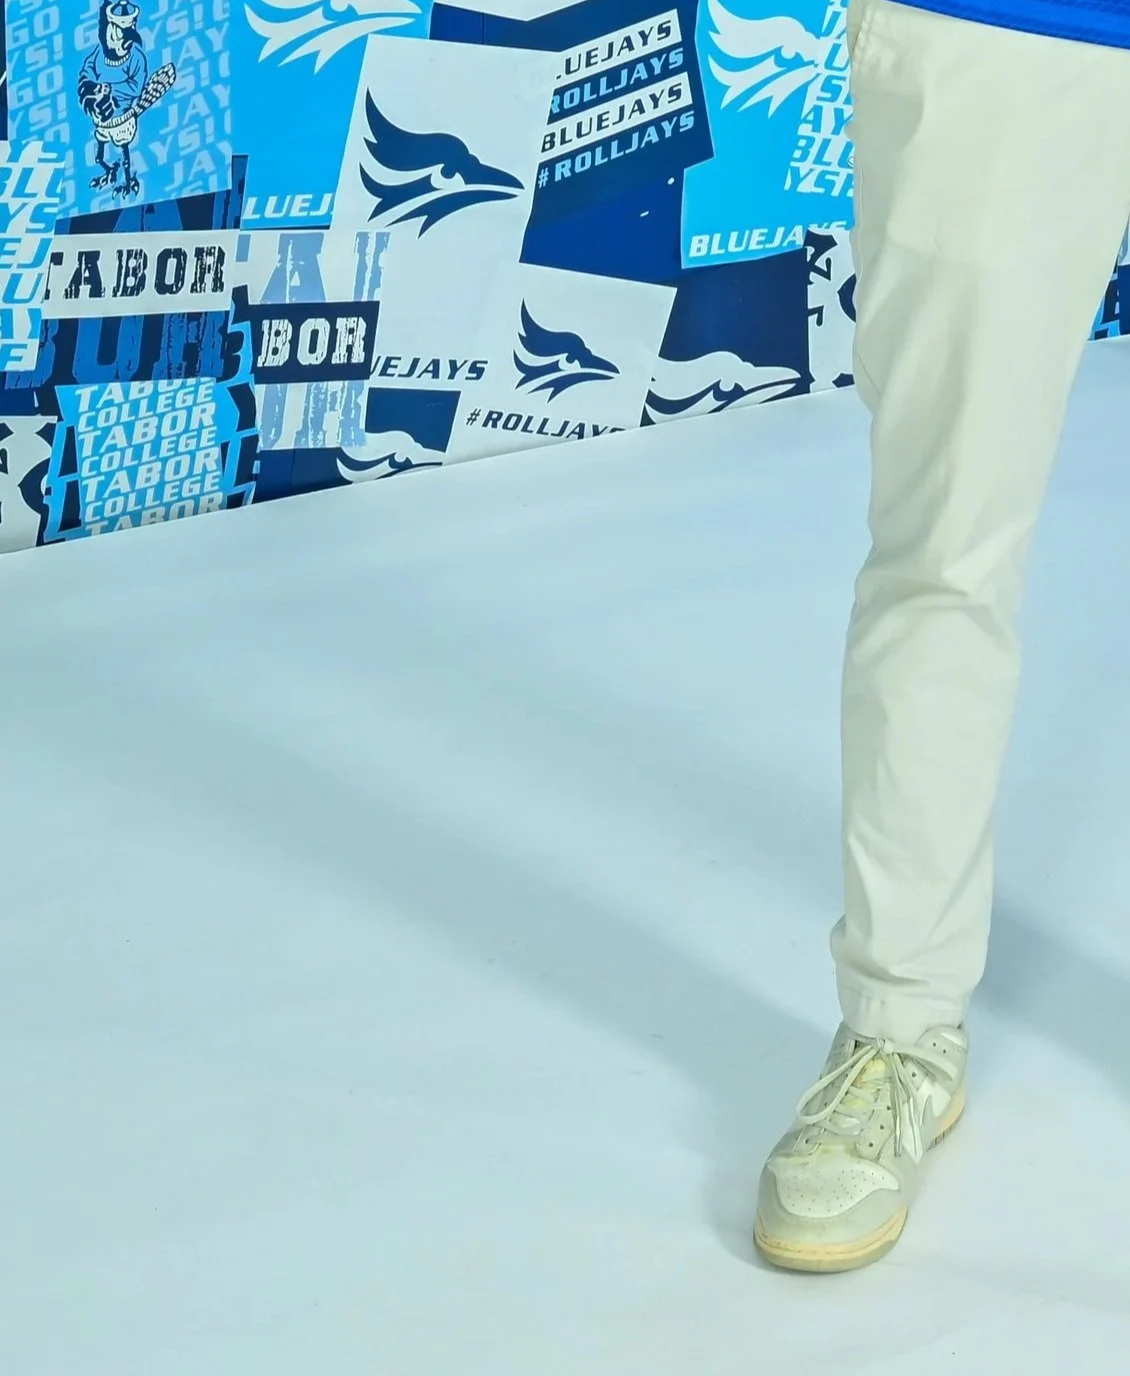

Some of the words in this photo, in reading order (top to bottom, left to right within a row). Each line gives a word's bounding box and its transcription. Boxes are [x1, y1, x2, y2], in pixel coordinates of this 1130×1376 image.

[541, 82, 684, 153] BLUEJAYS
[537, 110, 694, 188] #ROLLJAYS
[78, 382, 215, 433] COLLEGE
[78, 402, 216, 458] TABOR
[81, 426, 218, 478] COLLEGE
[82, 446, 220, 503] TABOR
[85, 471, 221, 523] COLLEGE
